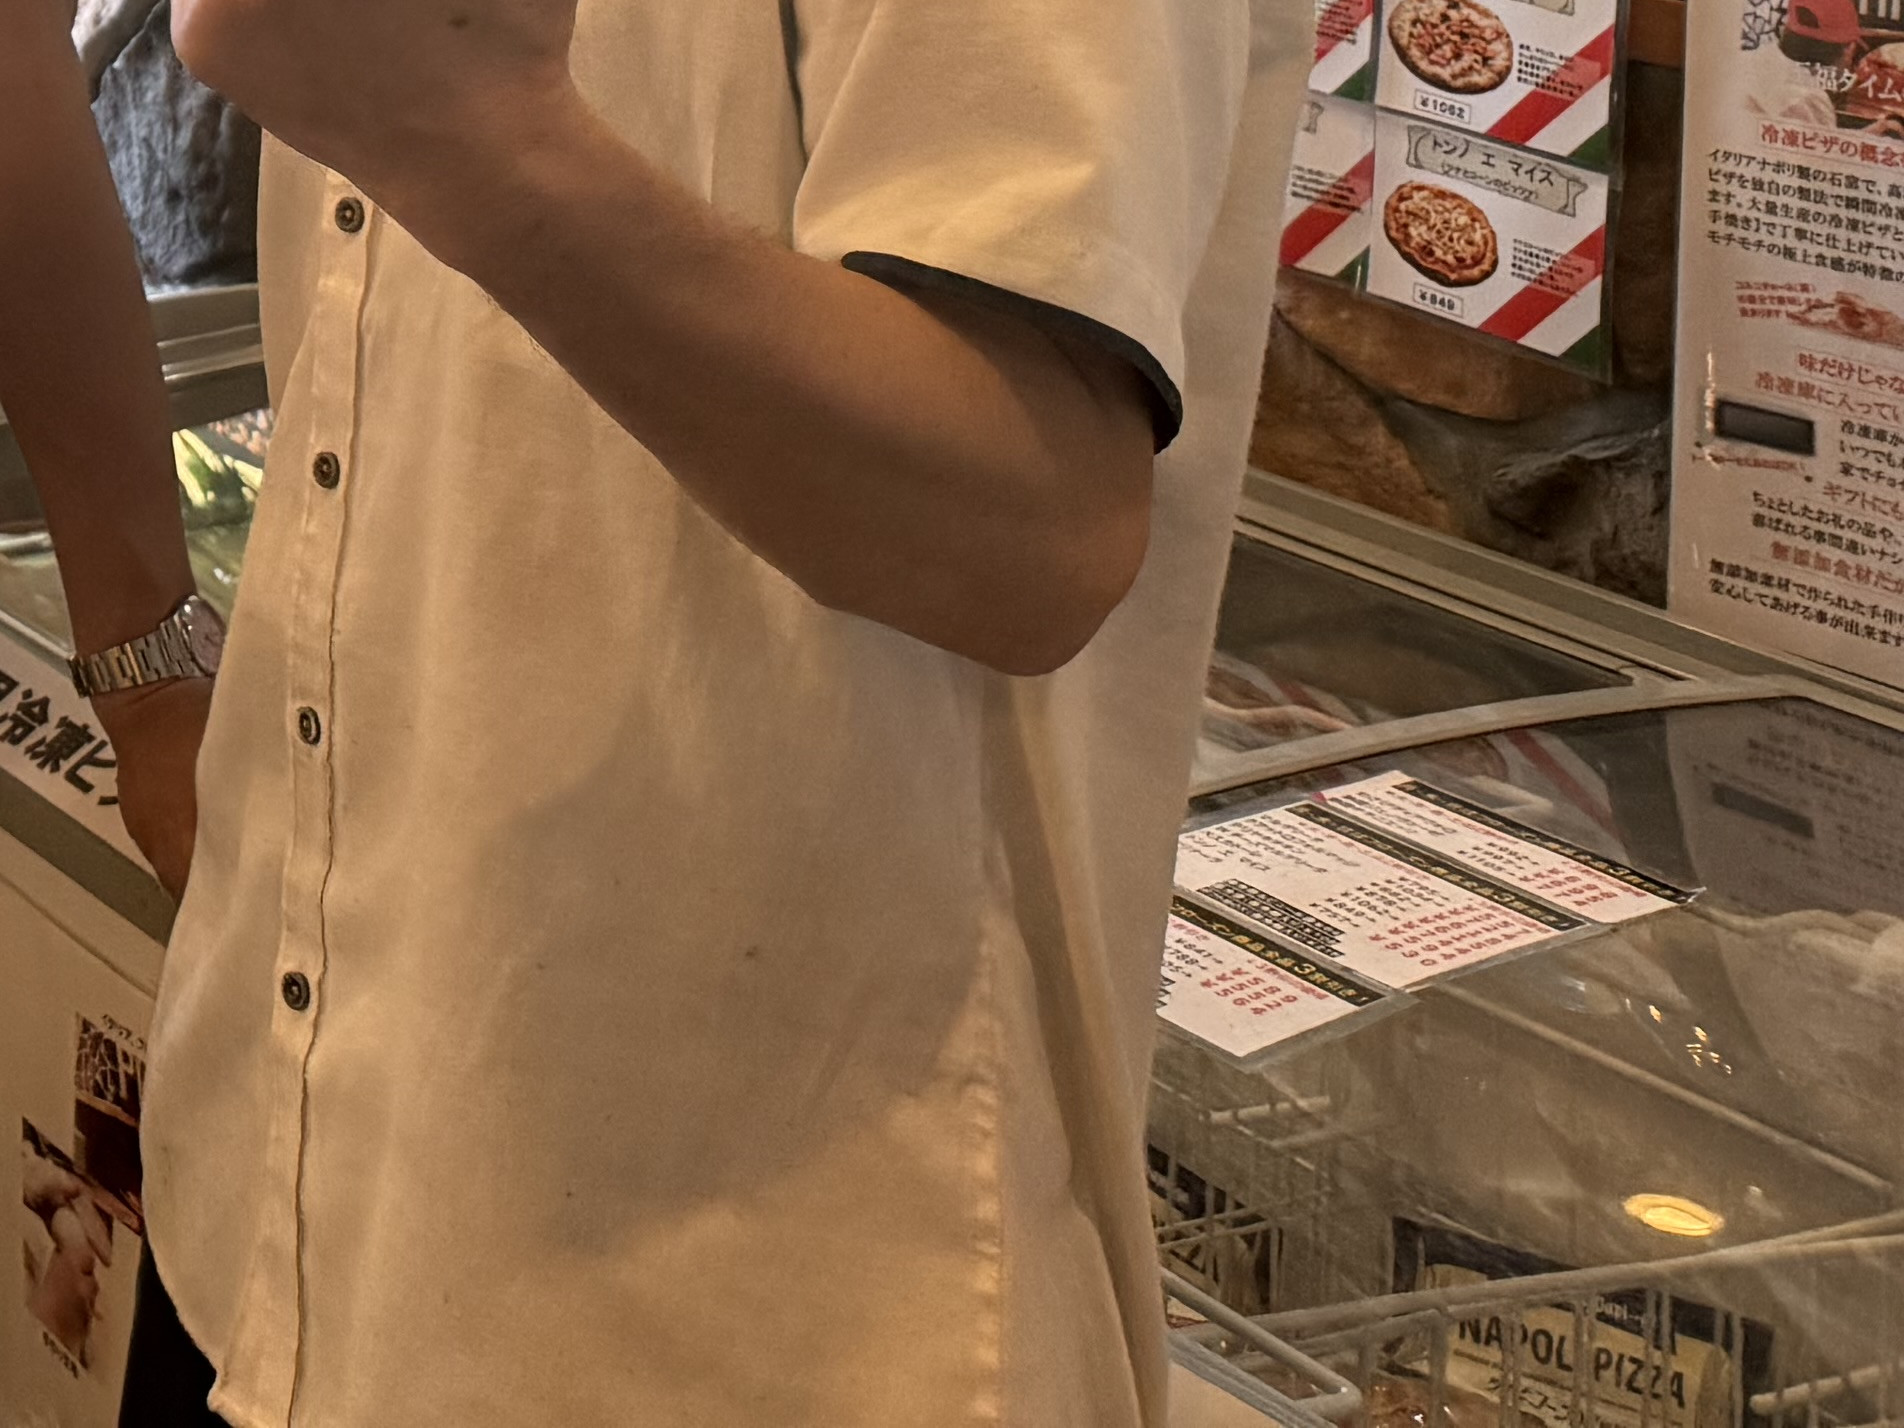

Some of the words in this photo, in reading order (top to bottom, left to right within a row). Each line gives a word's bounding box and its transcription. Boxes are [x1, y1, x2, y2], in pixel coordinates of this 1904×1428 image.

[1508, 158, 1556, 187] マイス
[1594, 1347, 1687, 1410] PIZZA
